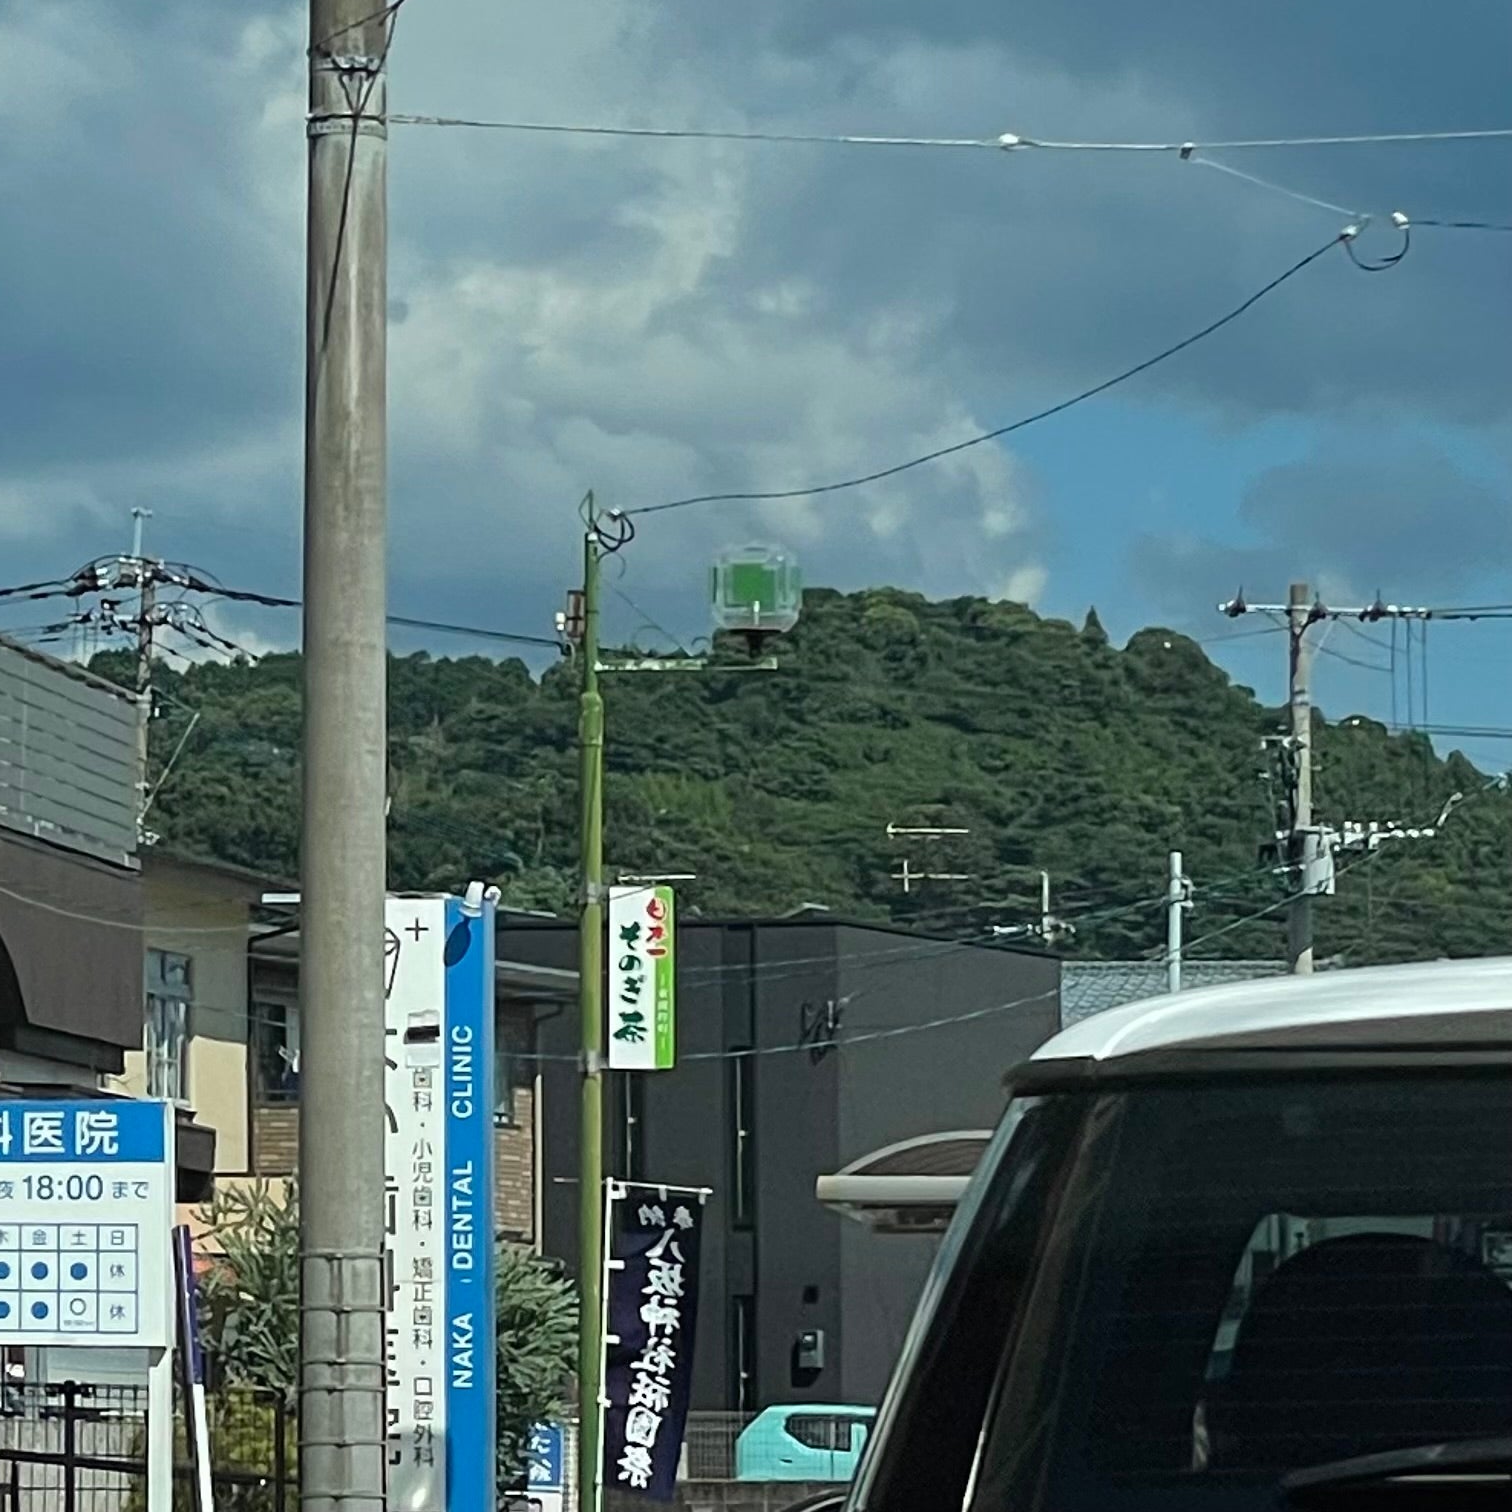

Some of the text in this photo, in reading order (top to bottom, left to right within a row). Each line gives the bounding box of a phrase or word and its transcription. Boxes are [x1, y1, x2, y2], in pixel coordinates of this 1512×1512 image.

[22, 1174, 104, 1201] 18:00
[112, 1181, 149, 1199] まで
[451, 1024, 473, 1388] NAKA DENTAL CLINIC
[31, 1229, 47, 1246] 金
[70, 1230, 88, 1246] 土
[110, 1230, 125, 1246] 日
[109, 1263, 125, 1278] 休
[109, 1304, 126, 1321] 休
